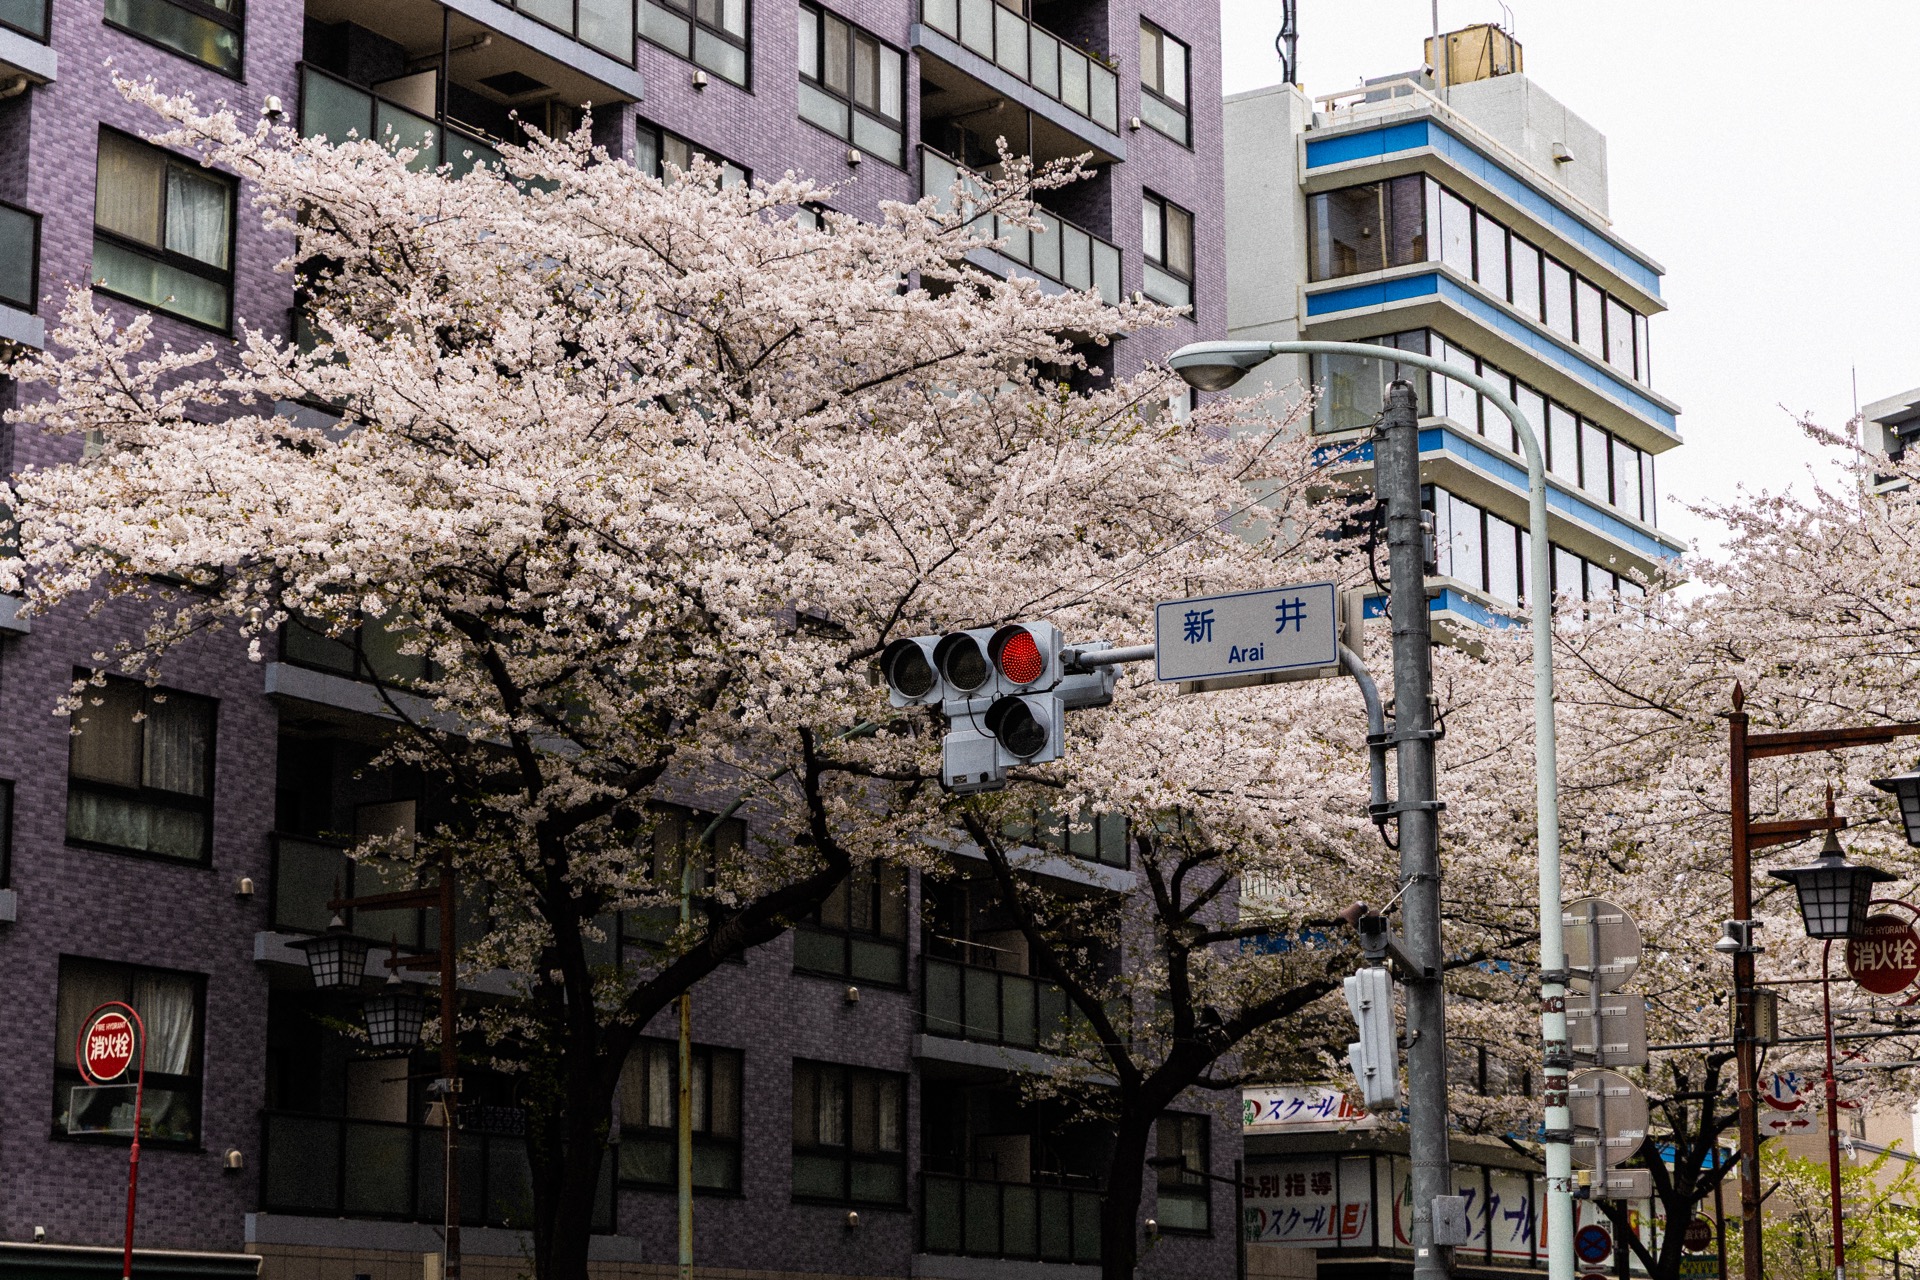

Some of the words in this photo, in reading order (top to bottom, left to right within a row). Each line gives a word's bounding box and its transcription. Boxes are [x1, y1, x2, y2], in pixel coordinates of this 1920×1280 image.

[1183, 596, 1307, 644] 新井
[1228, 643, 1264, 663] Arai
[1876, 925, 1909, 935] HYDRANT
[1853, 938, 1917, 971] 消火栓
[95, 1023, 105, 1031] FIRE
[106, 1021, 126, 1030] HYDRANT
[90, 1032, 130, 1060] 消火栓
